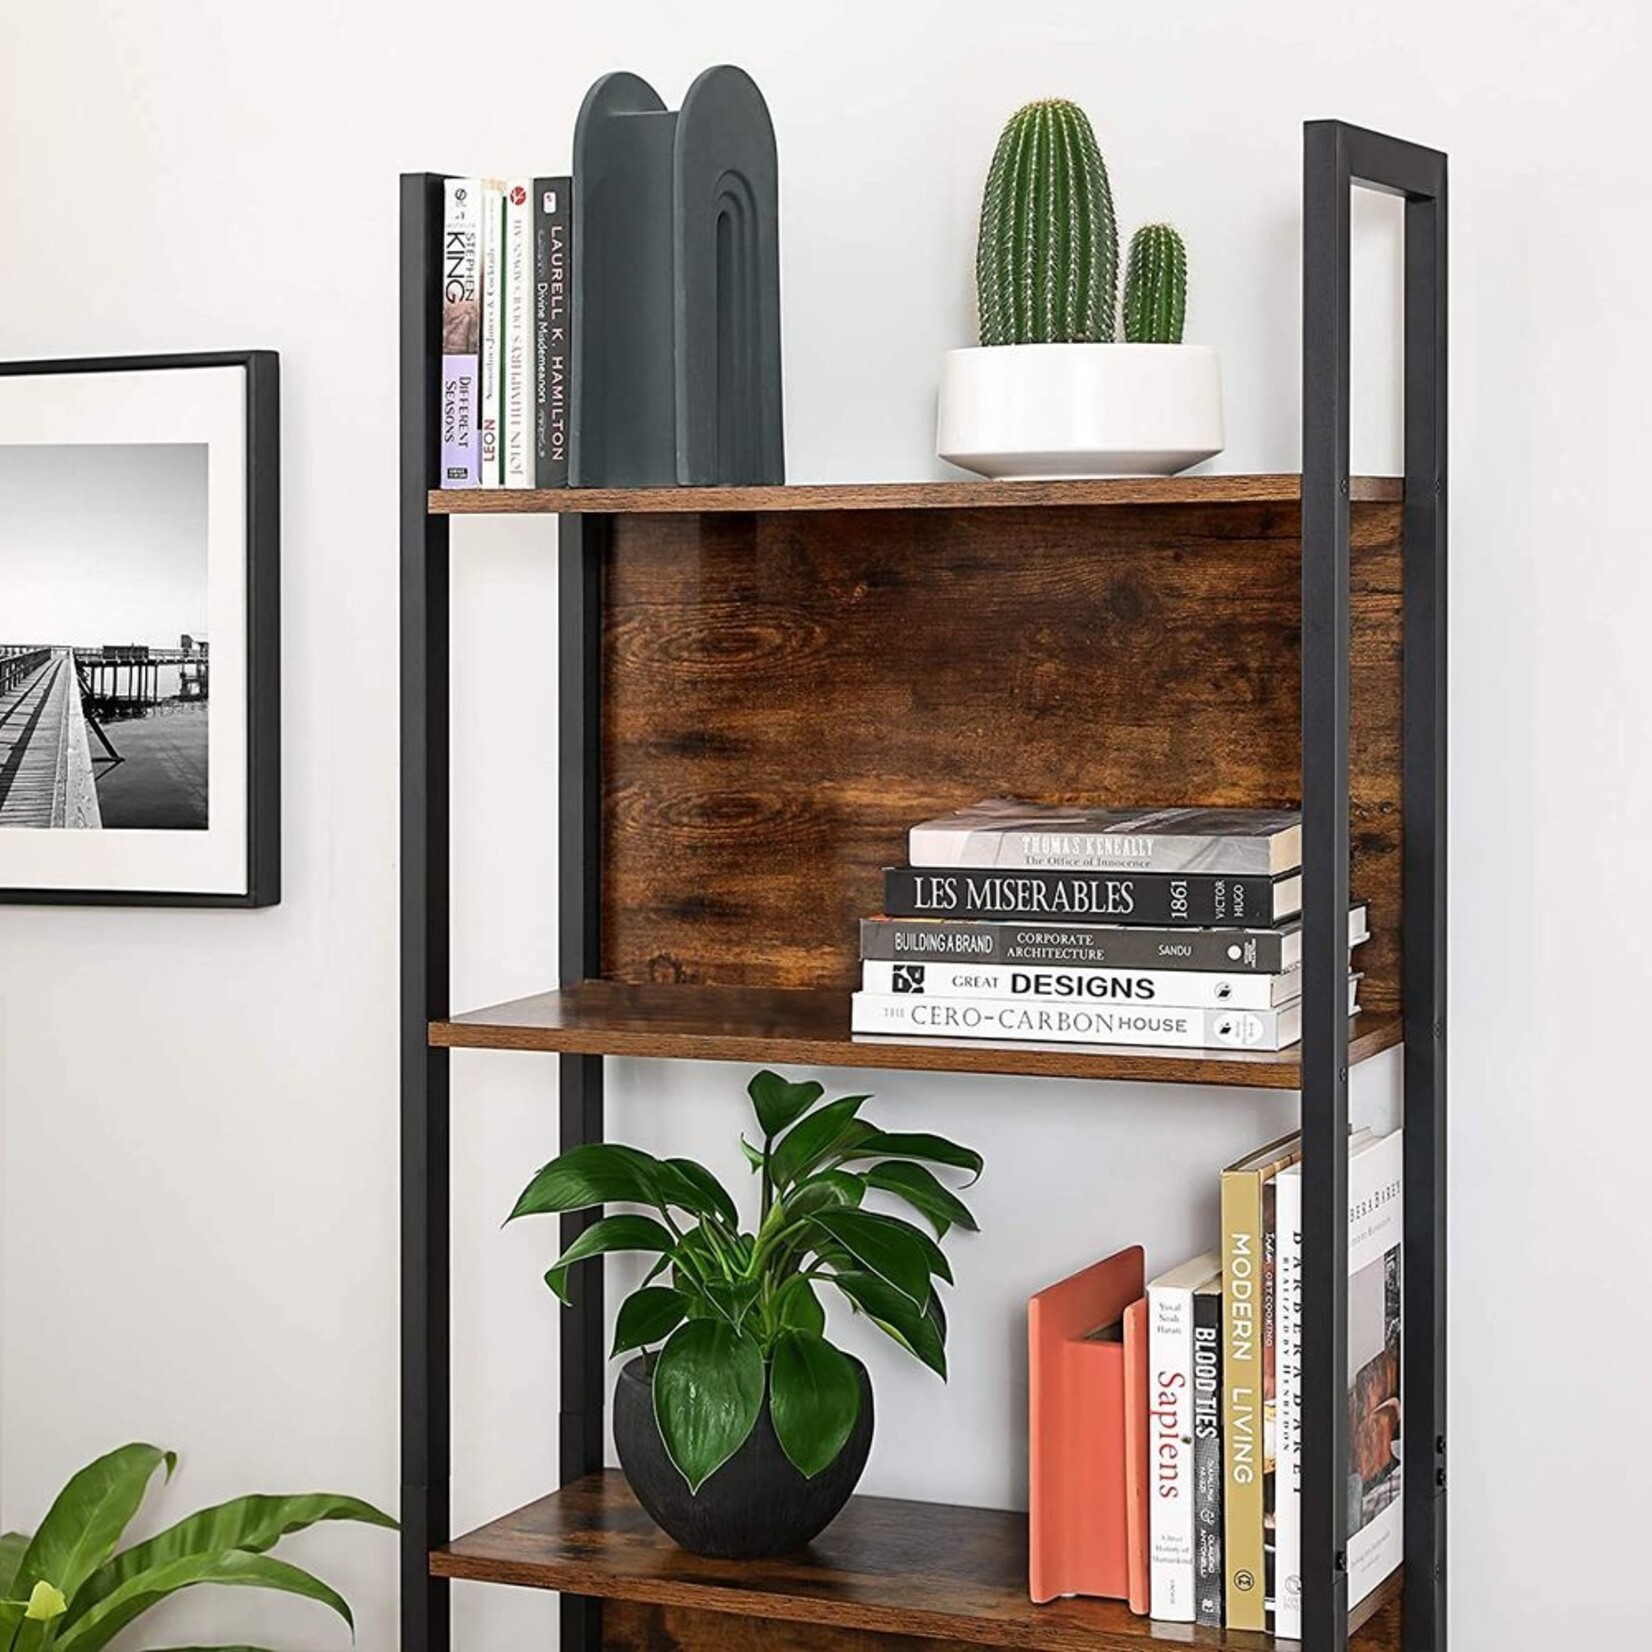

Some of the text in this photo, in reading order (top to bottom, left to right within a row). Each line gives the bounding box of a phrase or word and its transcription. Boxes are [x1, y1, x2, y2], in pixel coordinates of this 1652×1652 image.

[446, 232, 466, 304] KING
[465, 232, 476, 302] STEPHEN
[537, 283, 548, 319] Divine
[537, 321, 548, 404] Misdemeanors
[551, 226, 563, 461] LAURELL K. HAMILTON
[444, 381, 458, 443] SEASONS
[459, 376, 471, 448] DIFFERENT
[483, 419, 496, 462] LEON
[510, 431, 523, 475] JOHN
[1021, 836, 1154, 857] THOMAS KENEALLY
[1025, 856, 1152, 868] The Office of Innocence
[914, 876, 1134, 914] LES MISERABLES
[1170, 881, 1188, 919] 1861
[1215, 880, 1225, 919] VICTOR
[1233, 884, 1244, 917] HUGO
[1006, 946, 1105, 961] ARCHITECTURE
[1017, 932, 1094, 946] CORPORATE
[1158, 944, 1192, 957] SANDU
[952, 973, 1156, 1000] GREAT DESIGNS
[911, 1005, 1114, 1033] CERO-CARBON
[1118, 1017, 1187, 1033] HOUSE
[1231, 1234, 1254, 1484] MODERN LIVING
[1195, 1327, 1217, 1439] BLOOD TIES
[1151, 1370, 1186, 1499] Sapiens
